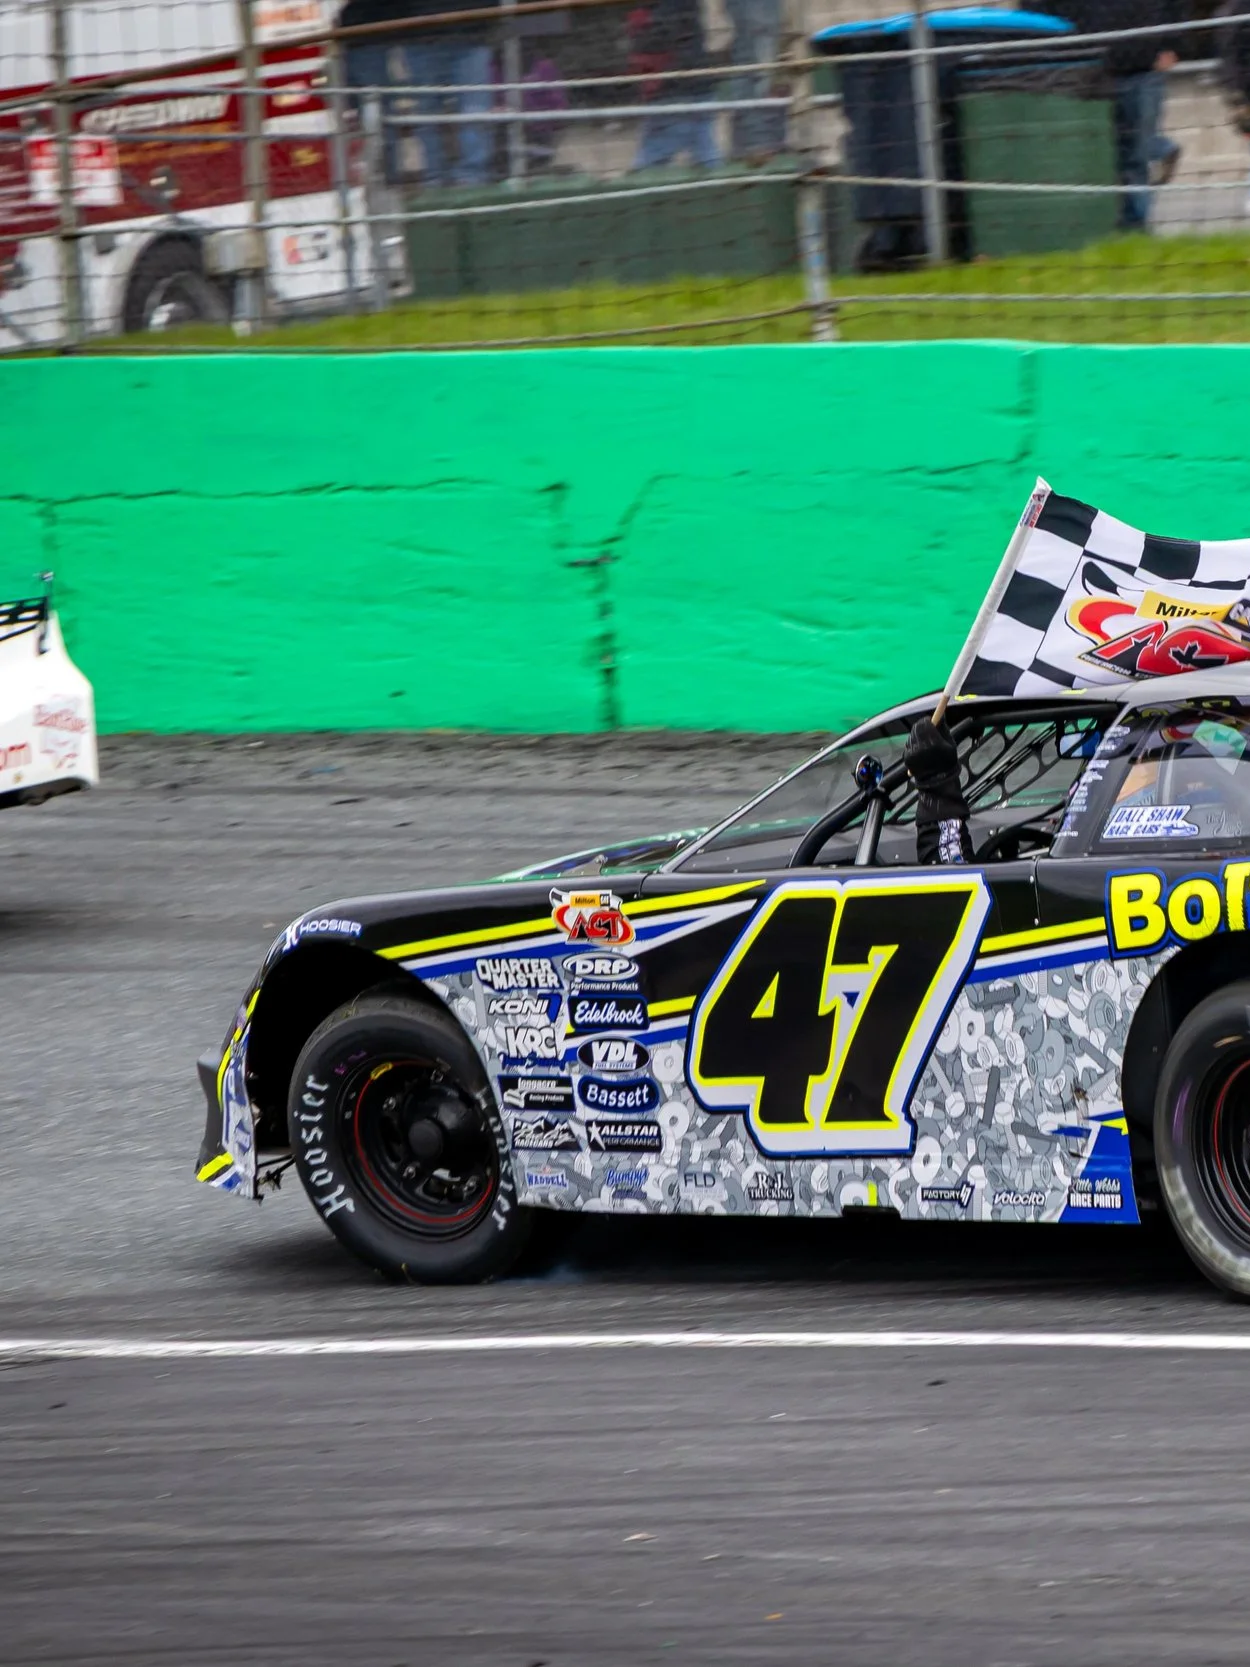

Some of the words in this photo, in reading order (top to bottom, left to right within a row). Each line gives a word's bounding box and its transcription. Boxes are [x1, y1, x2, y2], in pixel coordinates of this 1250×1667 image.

[1146, 805, 1185, 823] SHAW
[300, 918, 362, 936] HOOSIER
[568, 911, 624, 939] ACT
[476, 958, 553, 982] QUARTER
[575, 958, 630, 975] DRP
[493, 972, 560, 990] MASTER
[570, 982, 610, 991] Performance
[612, 981, 638, 990] Products
[488, 1000, 549, 1014] KONI
[574, 1001, 644, 1024] Edelbrock
[693, 880, 980, 1134] 47
[506, 1027, 558, 1058] KRC
[592, 1041, 638, 1063] VDL
[587, 1084, 649, 1108] Bassett
[601, 1125, 658, 1137] ALLSTAR
[293, 1074, 356, 1218] Hoosier
[603, 1138, 660, 1147] PERFORMANCE
[749, 1187, 794, 1200] TRUCKING
[923, 1189, 961, 1200] FACTORY
[1070, 1193, 1092, 1208] RACE
[1093, 1193, 1121, 1209] PARTS
